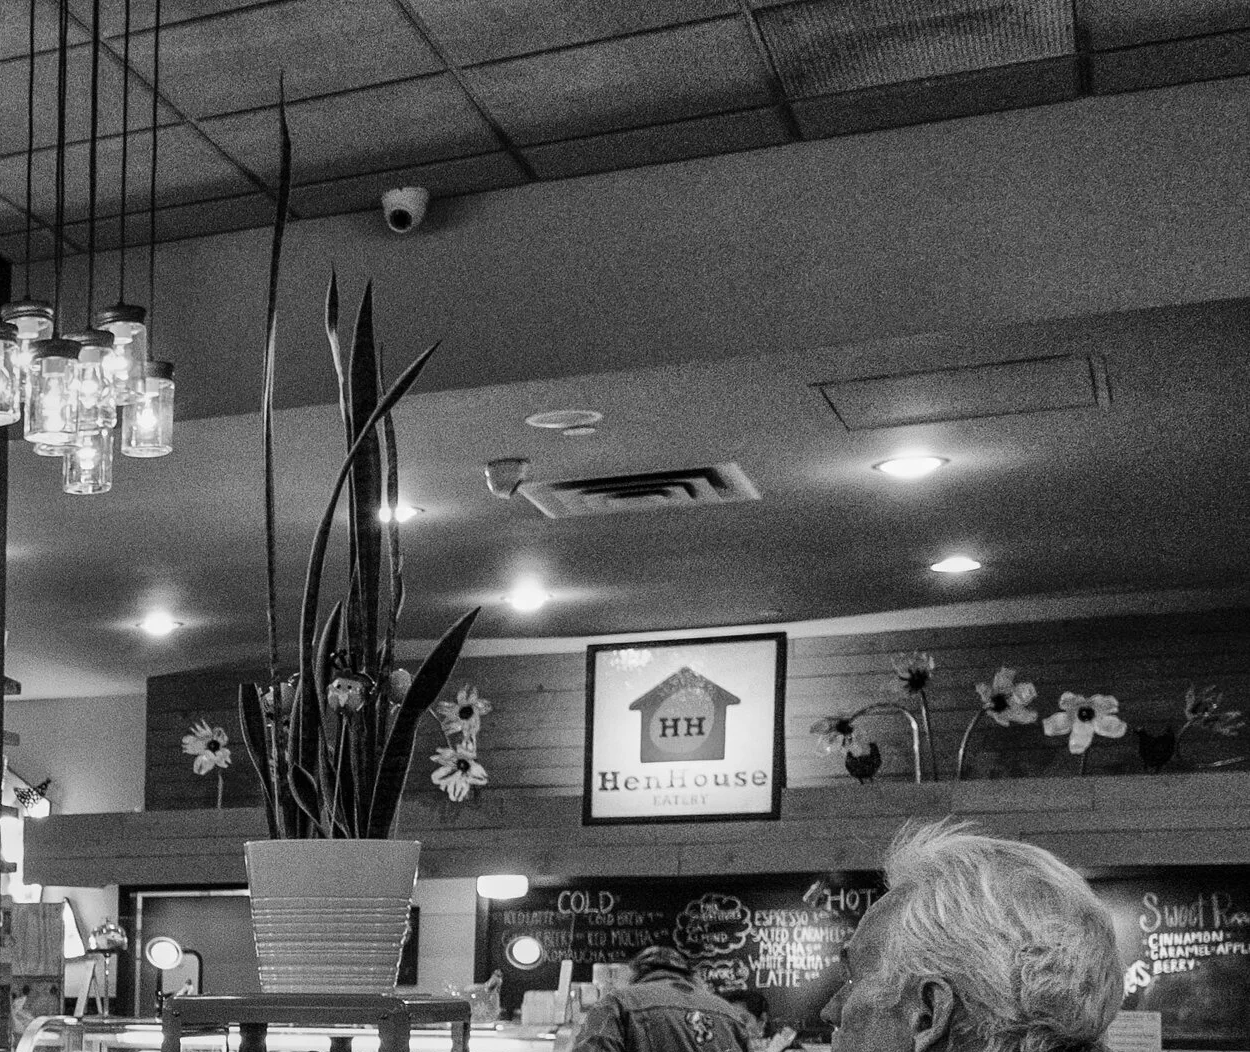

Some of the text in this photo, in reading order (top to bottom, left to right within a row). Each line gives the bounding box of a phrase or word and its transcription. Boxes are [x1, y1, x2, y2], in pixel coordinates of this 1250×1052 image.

[659, 717, 706, 738] HH
[598, 769, 768, 791] HenHouse
[653, 794, 709, 807] EATERY
[558, 890, 614, 914] COLD
[823, 887, 877, 911] HOT
[1148, 930, 1224, 949] CINNAMON
[1150, 942, 1250, 960] CARAMEL APPL
[1153, 958, 1195, 975] BERRY
[756, 968, 800, 988] LATTE
